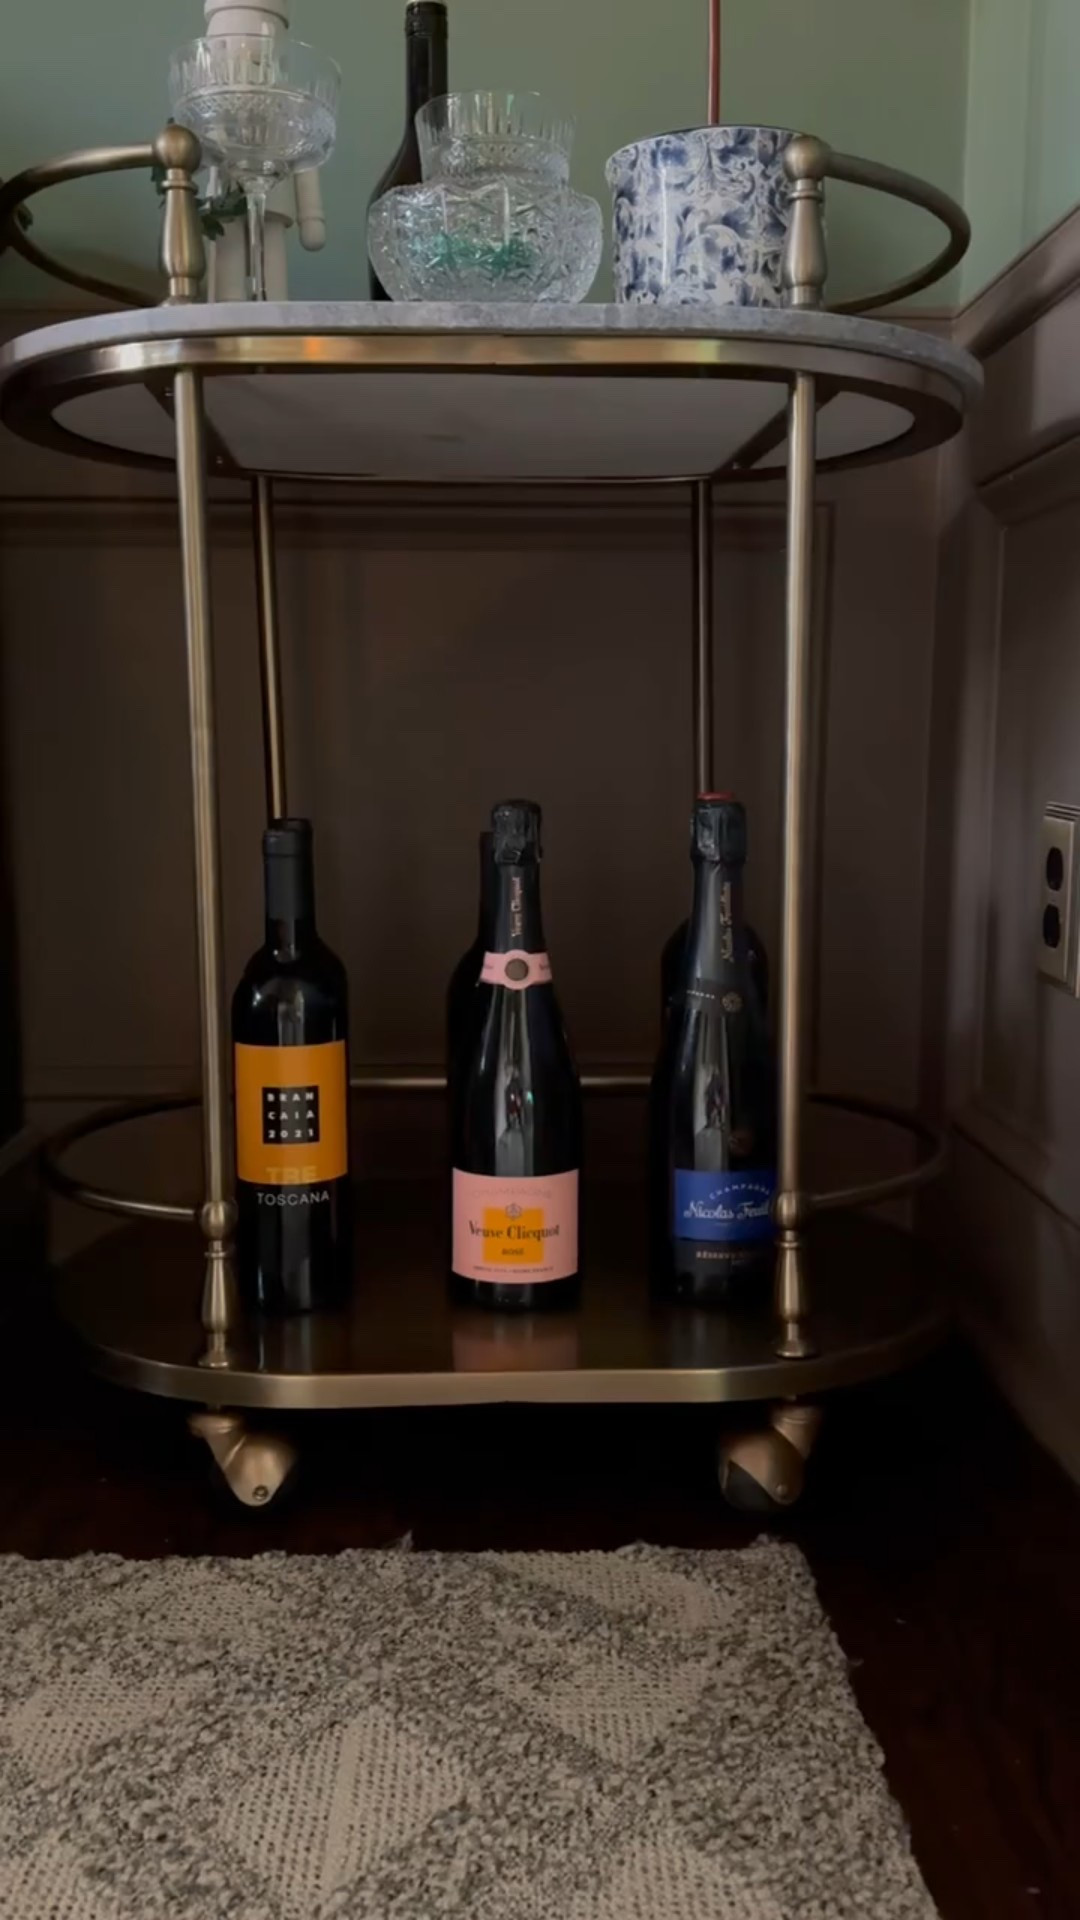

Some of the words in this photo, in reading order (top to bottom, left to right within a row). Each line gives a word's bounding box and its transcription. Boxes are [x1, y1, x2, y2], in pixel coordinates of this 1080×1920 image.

[266, 1091, 315, 1103] BRAN
[267, 1109, 316, 1121] CAIA
[267, 1128, 315, 1139] 2021
[256, 1190, 331, 1206] TOSCANA
[683, 1200, 734, 1219] Nicolas
[468, 1219, 504, 1239] Veuve
[506, 1224, 560, 1242] Clicquot
